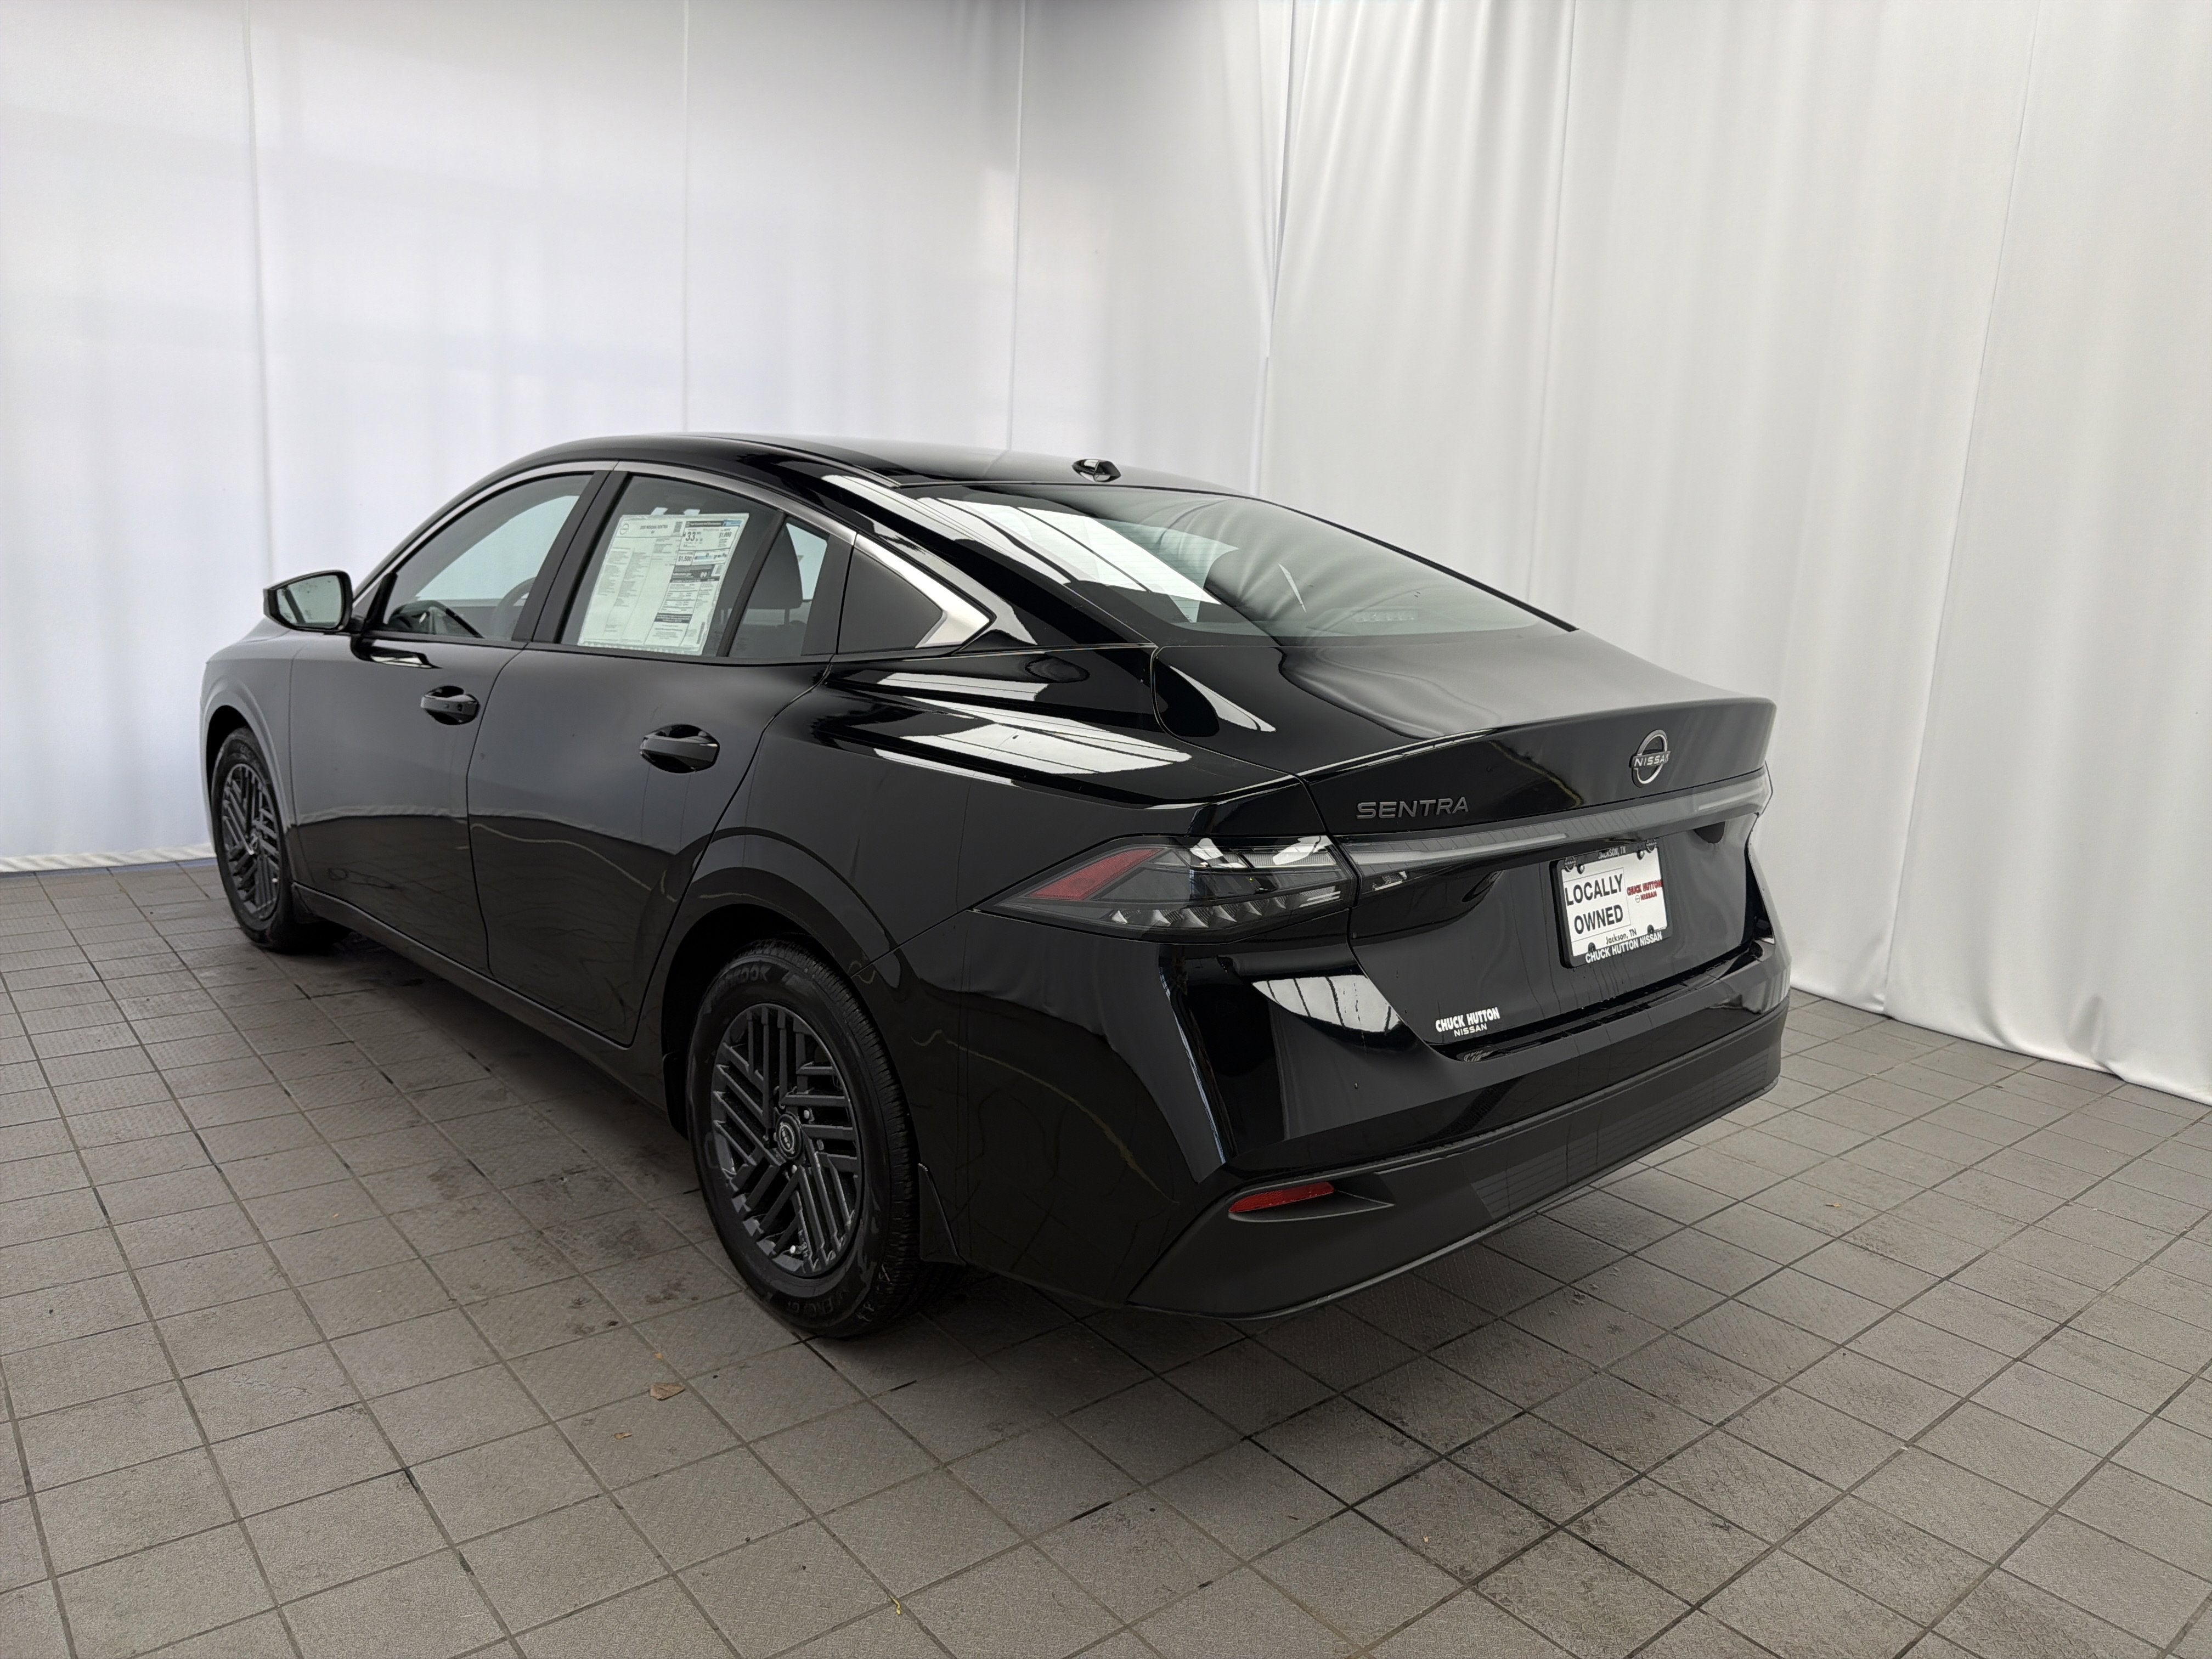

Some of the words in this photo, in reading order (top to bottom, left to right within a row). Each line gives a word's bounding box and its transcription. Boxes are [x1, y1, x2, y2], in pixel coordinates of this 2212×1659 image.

[685, 531, 696, 541] 33
[1634, 752, 1669, 767] NISSAN
[1356, 797, 1469, 819] SENTRA
[1620, 845, 1626, 854] TN
[1565, 873, 1623, 906] LOCALLY
[1627, 884, 1642, 896] CHUCK
[1640, 890, 1657, 901] NISSAN
[1574, 904, 1623, 934] OWNED
[1606, 934, 1629, 945] Jackson,
[1629, 928, 1637, 938] TN
[1585, 947, 1611, 963] CHUCK
[1612, 940, 1639, 956] HUTTON
[1640, 931, 1662, 946] NISSAN
[1435, 1014, 1465, 1032] CHUCK
[1466, 1007, 1500, 1025] HUTTON
[1454, 1023, 1487, 1037] NISSAN
